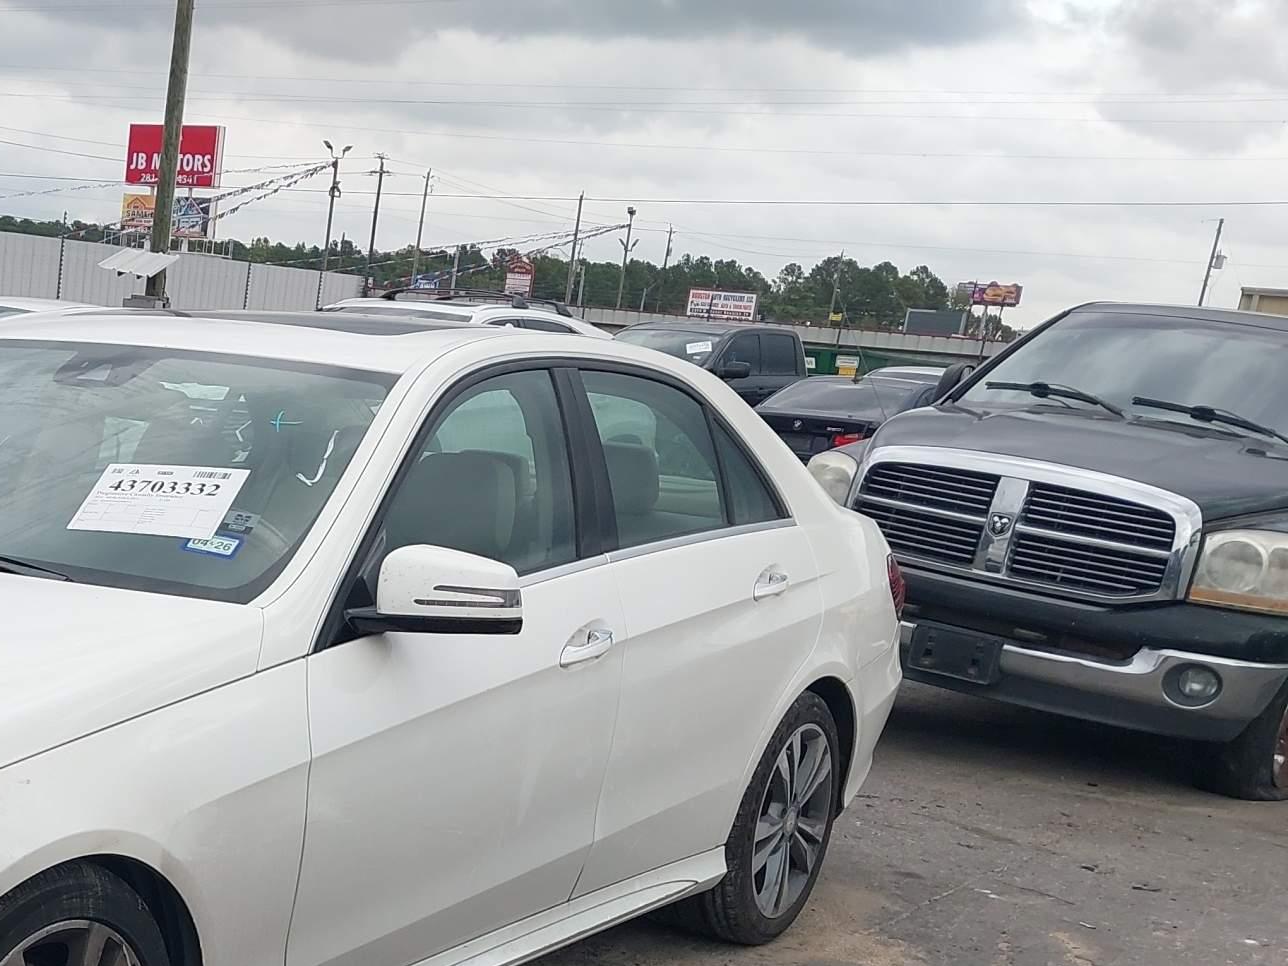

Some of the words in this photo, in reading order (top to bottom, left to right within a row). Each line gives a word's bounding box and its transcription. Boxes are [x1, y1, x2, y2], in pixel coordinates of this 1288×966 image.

[129, 152, 147, 170] JB
[151, 152, 212, 172] MTORS
[109, 479, 220, 496] 43703332
[214, 541, 233, 551] 26
